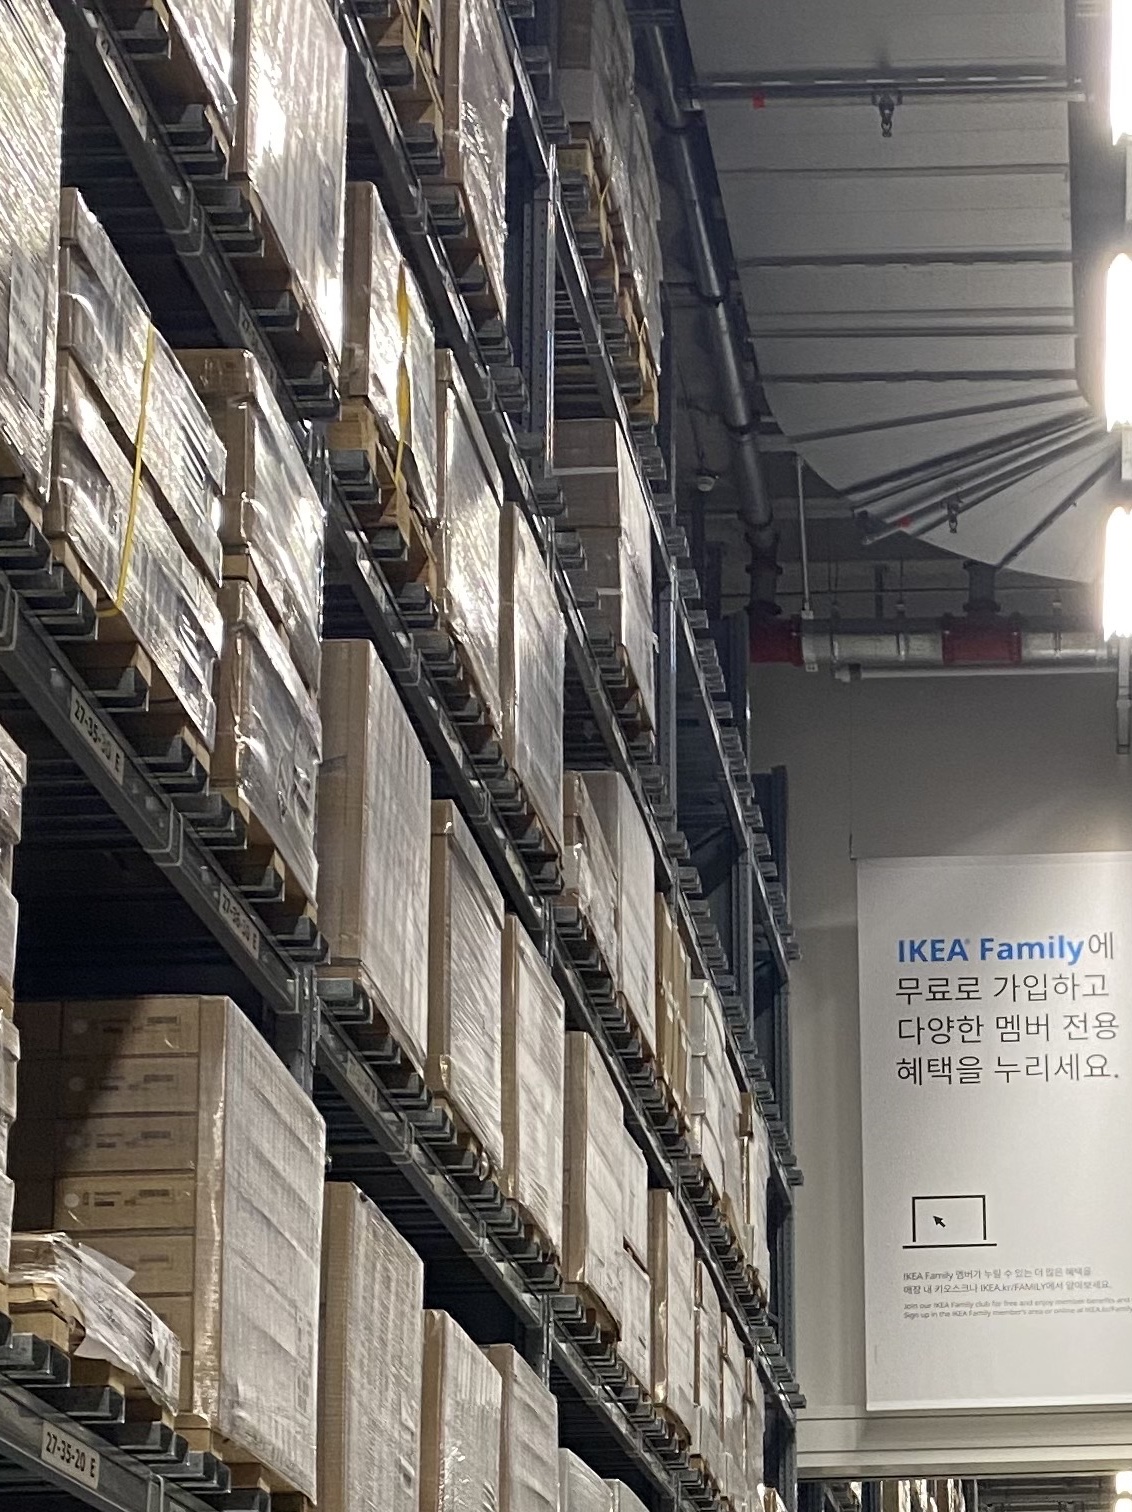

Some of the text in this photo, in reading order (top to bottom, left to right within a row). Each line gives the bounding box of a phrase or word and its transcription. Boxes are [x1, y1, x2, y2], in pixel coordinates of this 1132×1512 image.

[896, 972, 1110, 1005] 무료로 가입하고
[898, 1012, 1120, 1045] 다양한 멤버 전용
[896, 1052, 1119, 1086] 혜택을 누리세요.
[903, 1271, 923, 1280] IKEA
[925, 1271, 953, 1281] Family
[1034, 1268, 1043, 1278] 더
[45, 1431, 96, 1478] 27-35-20 E
